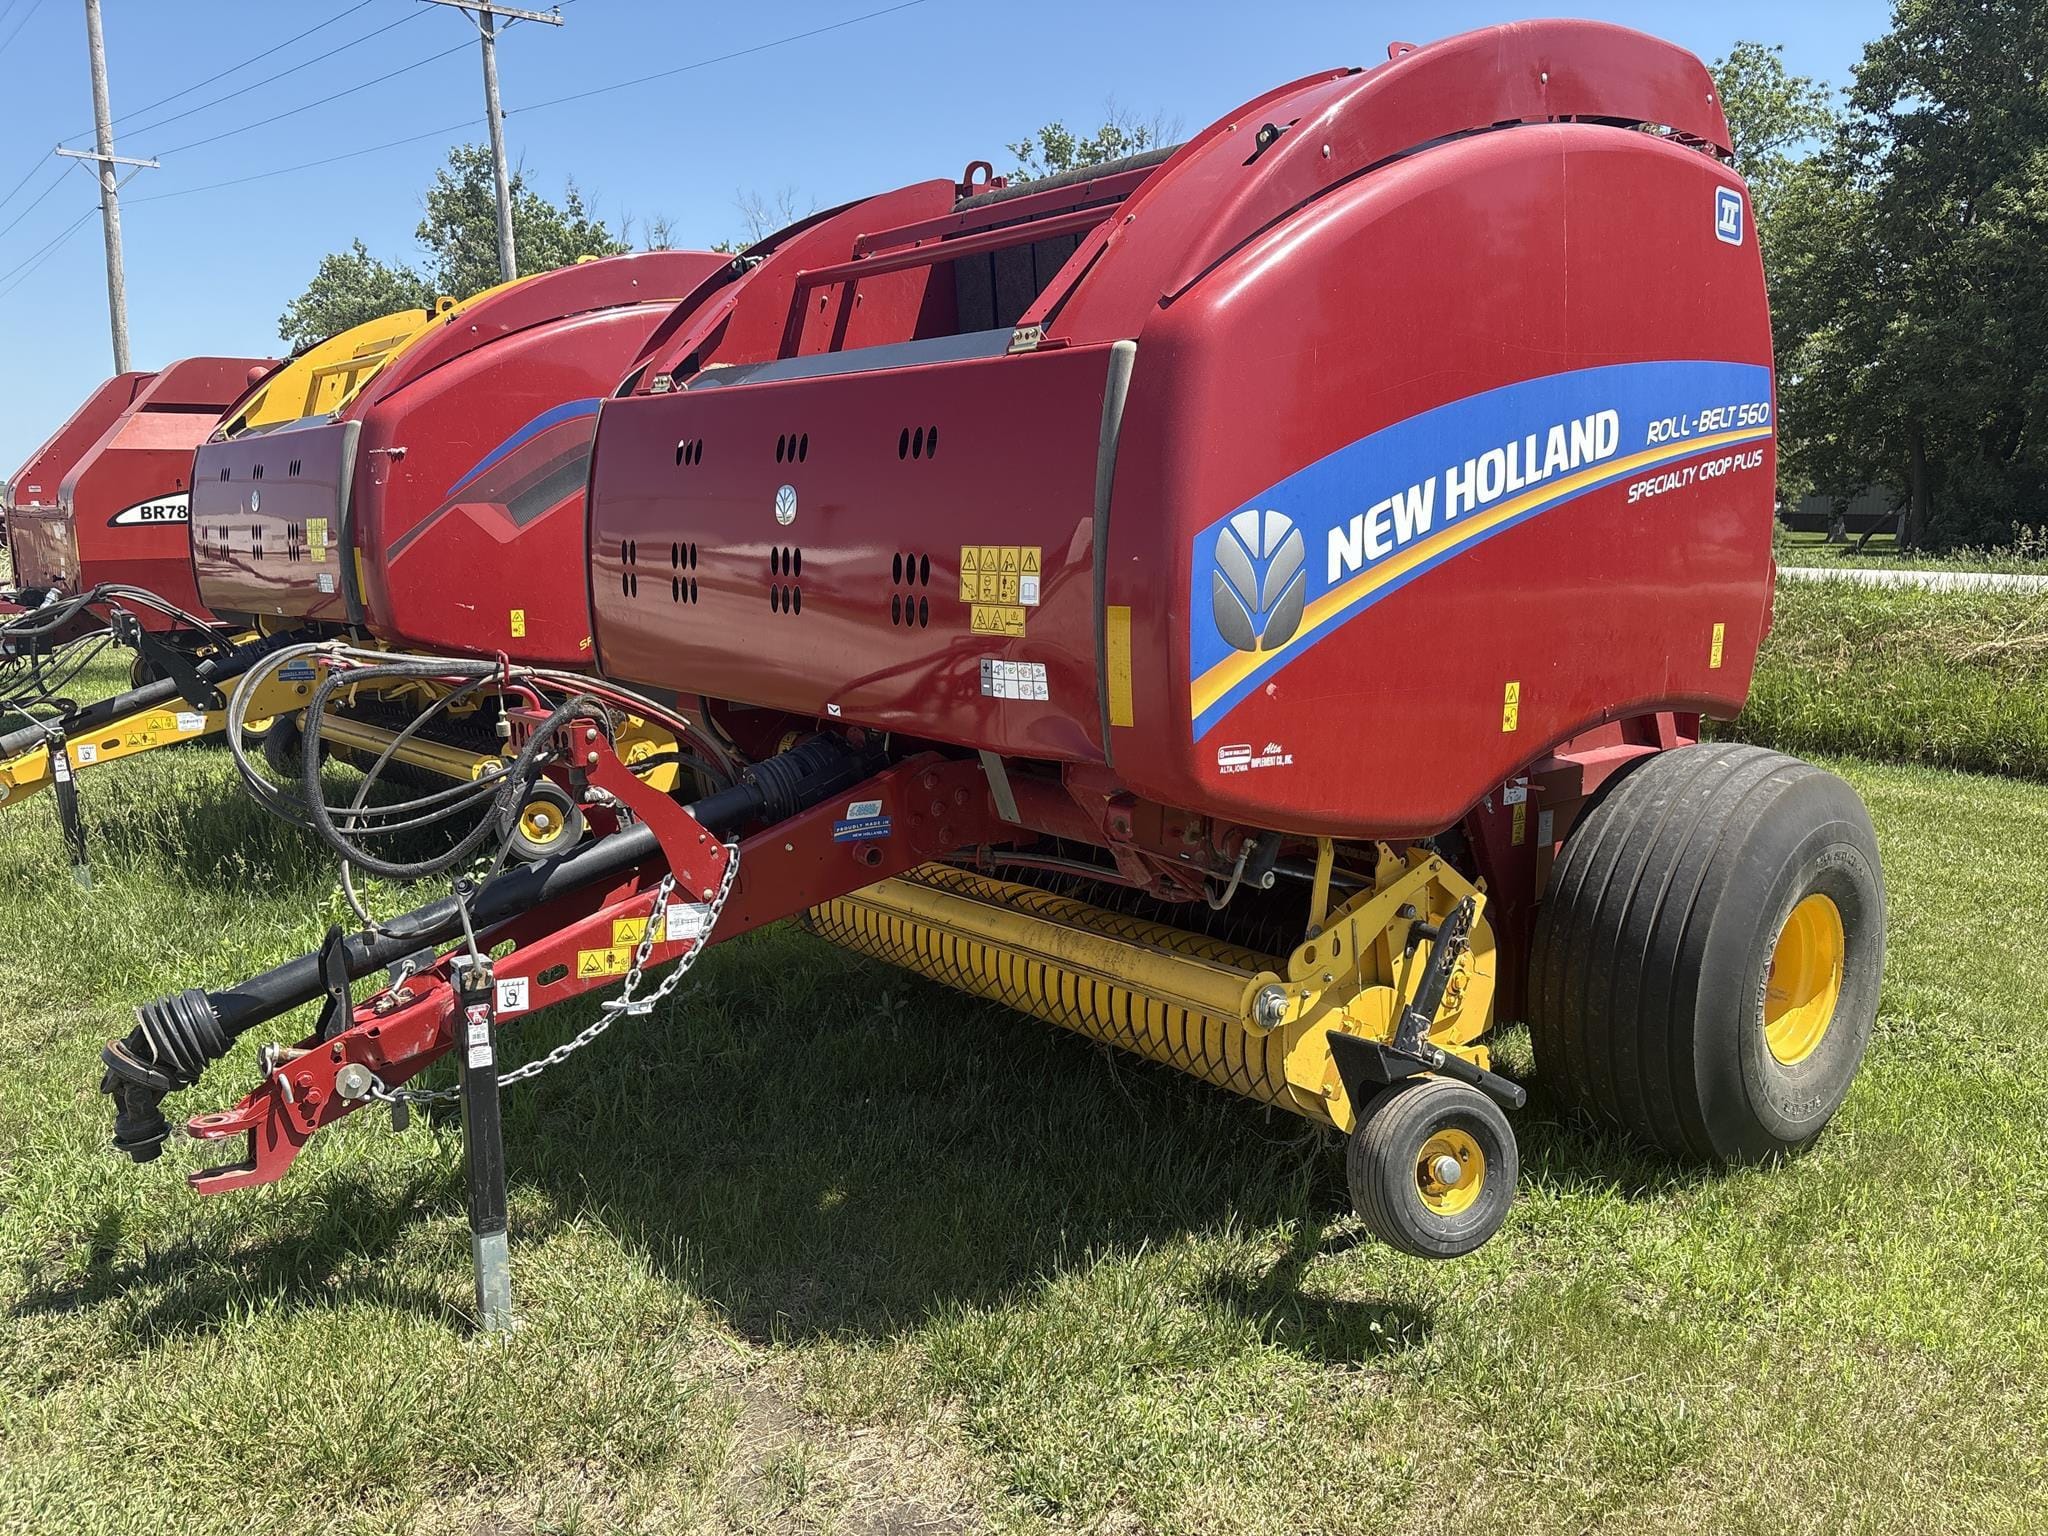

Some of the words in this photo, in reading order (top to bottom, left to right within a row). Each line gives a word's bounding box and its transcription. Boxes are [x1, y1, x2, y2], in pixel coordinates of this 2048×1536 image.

[1646, 405, 1737, 446] ROLL-BELT
[1737, 402, 1770, 427] 560
[1327, 476, 1437, 585] NEW
[1445, 408, 1620, 521] HOLLAND
[1627, 465, 1698, 504] SPECIALTY
[1699, 456, 1732, 481] CROP
[1732, 449, 1764, 472] PLUS
[836, 823, 863, 833] PROUDLY
